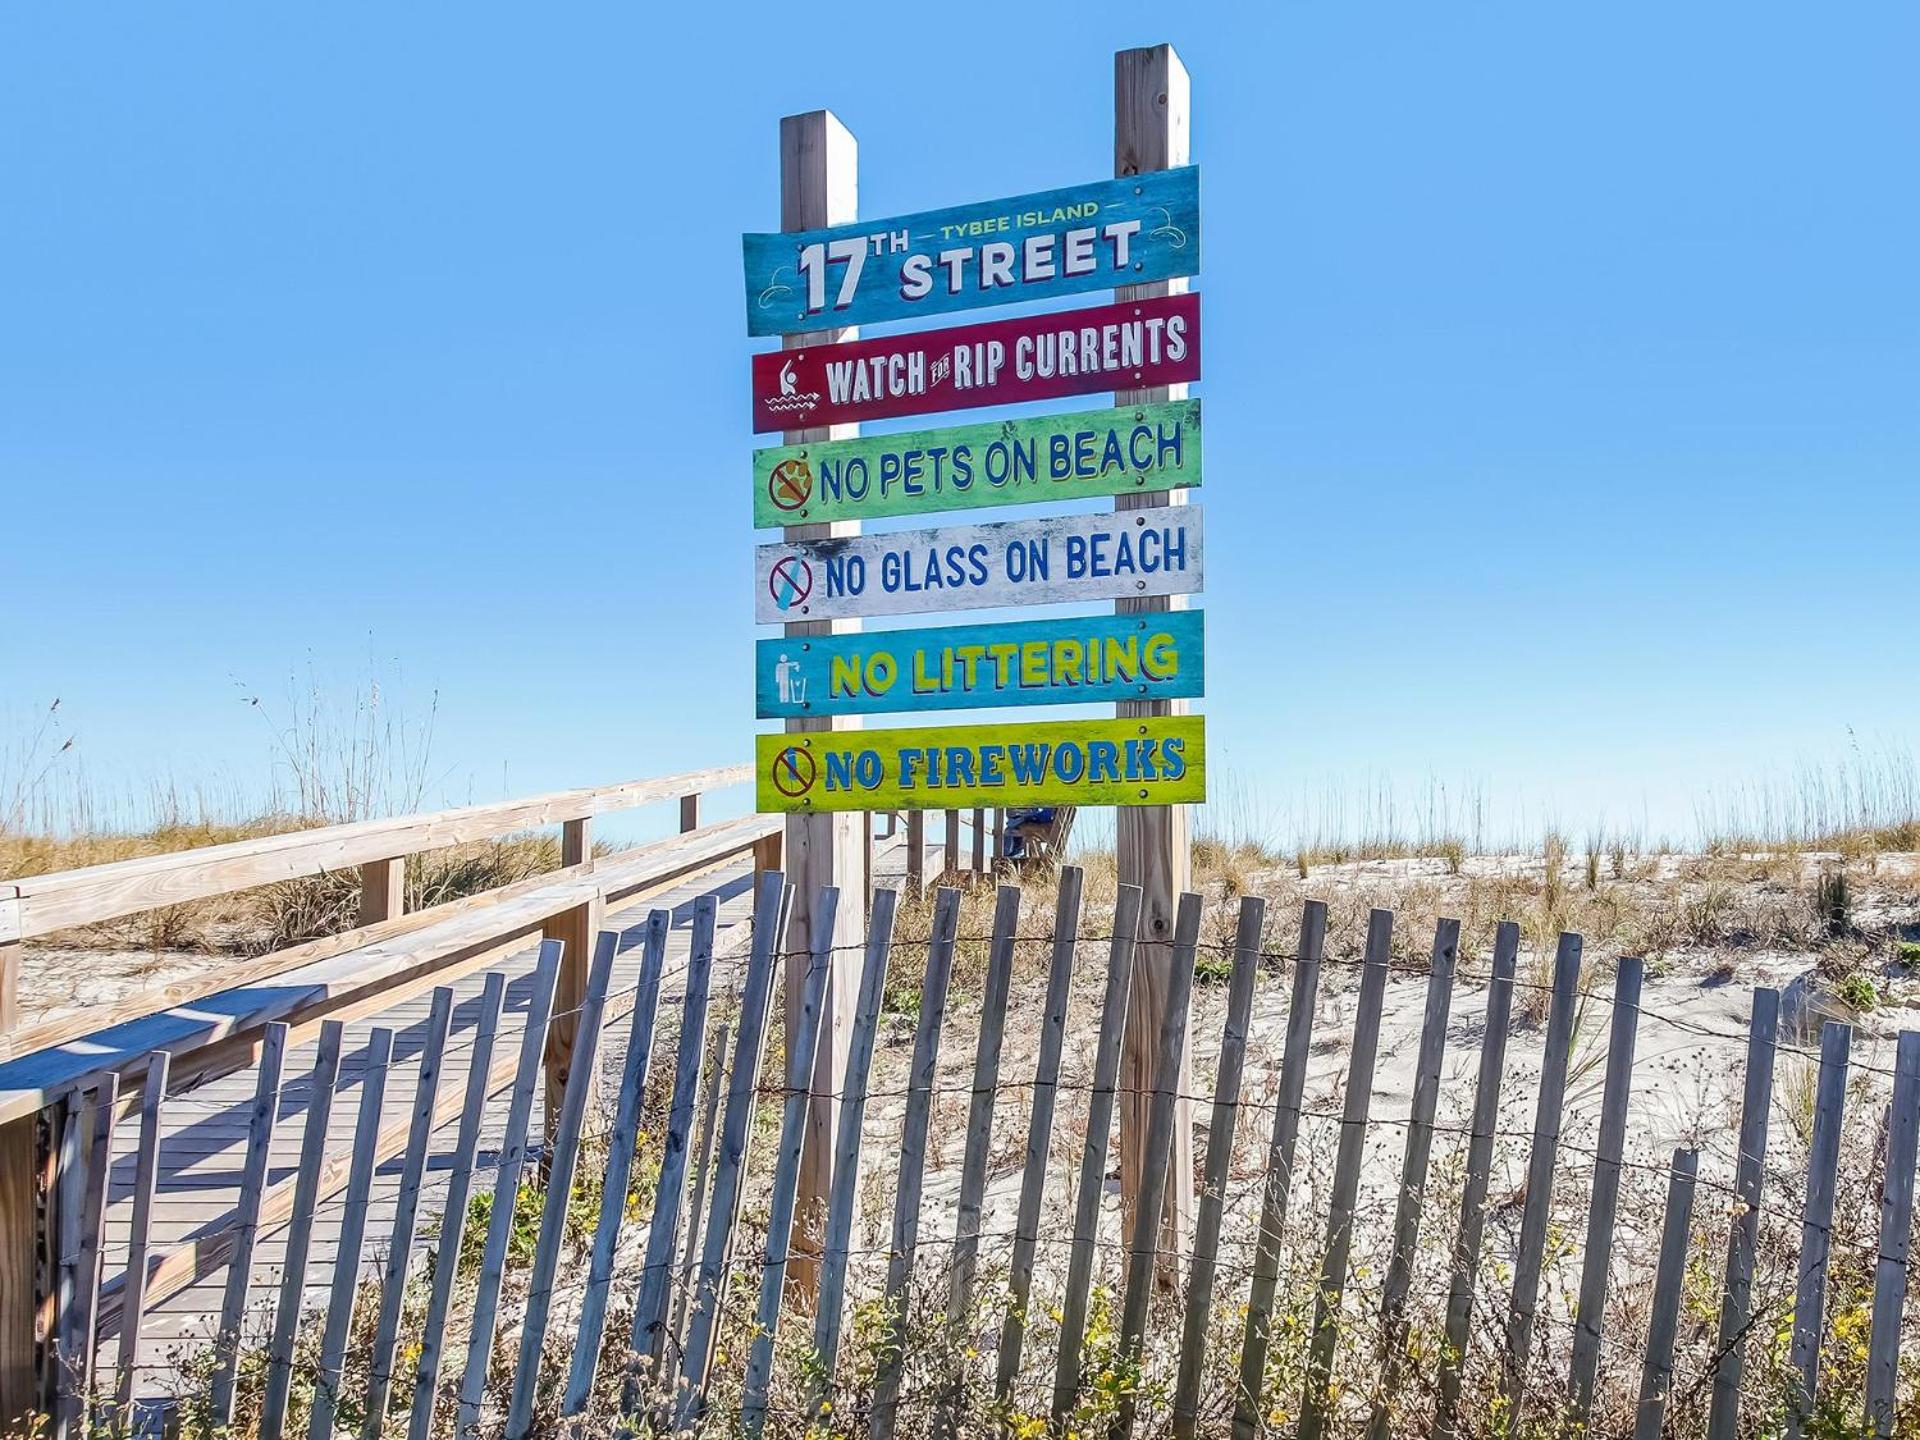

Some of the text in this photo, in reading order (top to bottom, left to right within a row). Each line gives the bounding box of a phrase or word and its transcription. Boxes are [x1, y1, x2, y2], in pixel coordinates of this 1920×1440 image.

[940, 202, 1099, 241] TYBEE ISLAND
[799, 220, 1141, 315] 17TH STREET
[825, 315, 1187, 405] WATCH FOR RIP CURRENTS
[819, 422, 1183, 502] NO PETS ON BEACH
[825, 527, 1186, 599] NO GLASS ON BEACH
[829, 633, 1179, 699] NO LITTERING
[824, 737, 1186, 791] NO FIREWORKS
